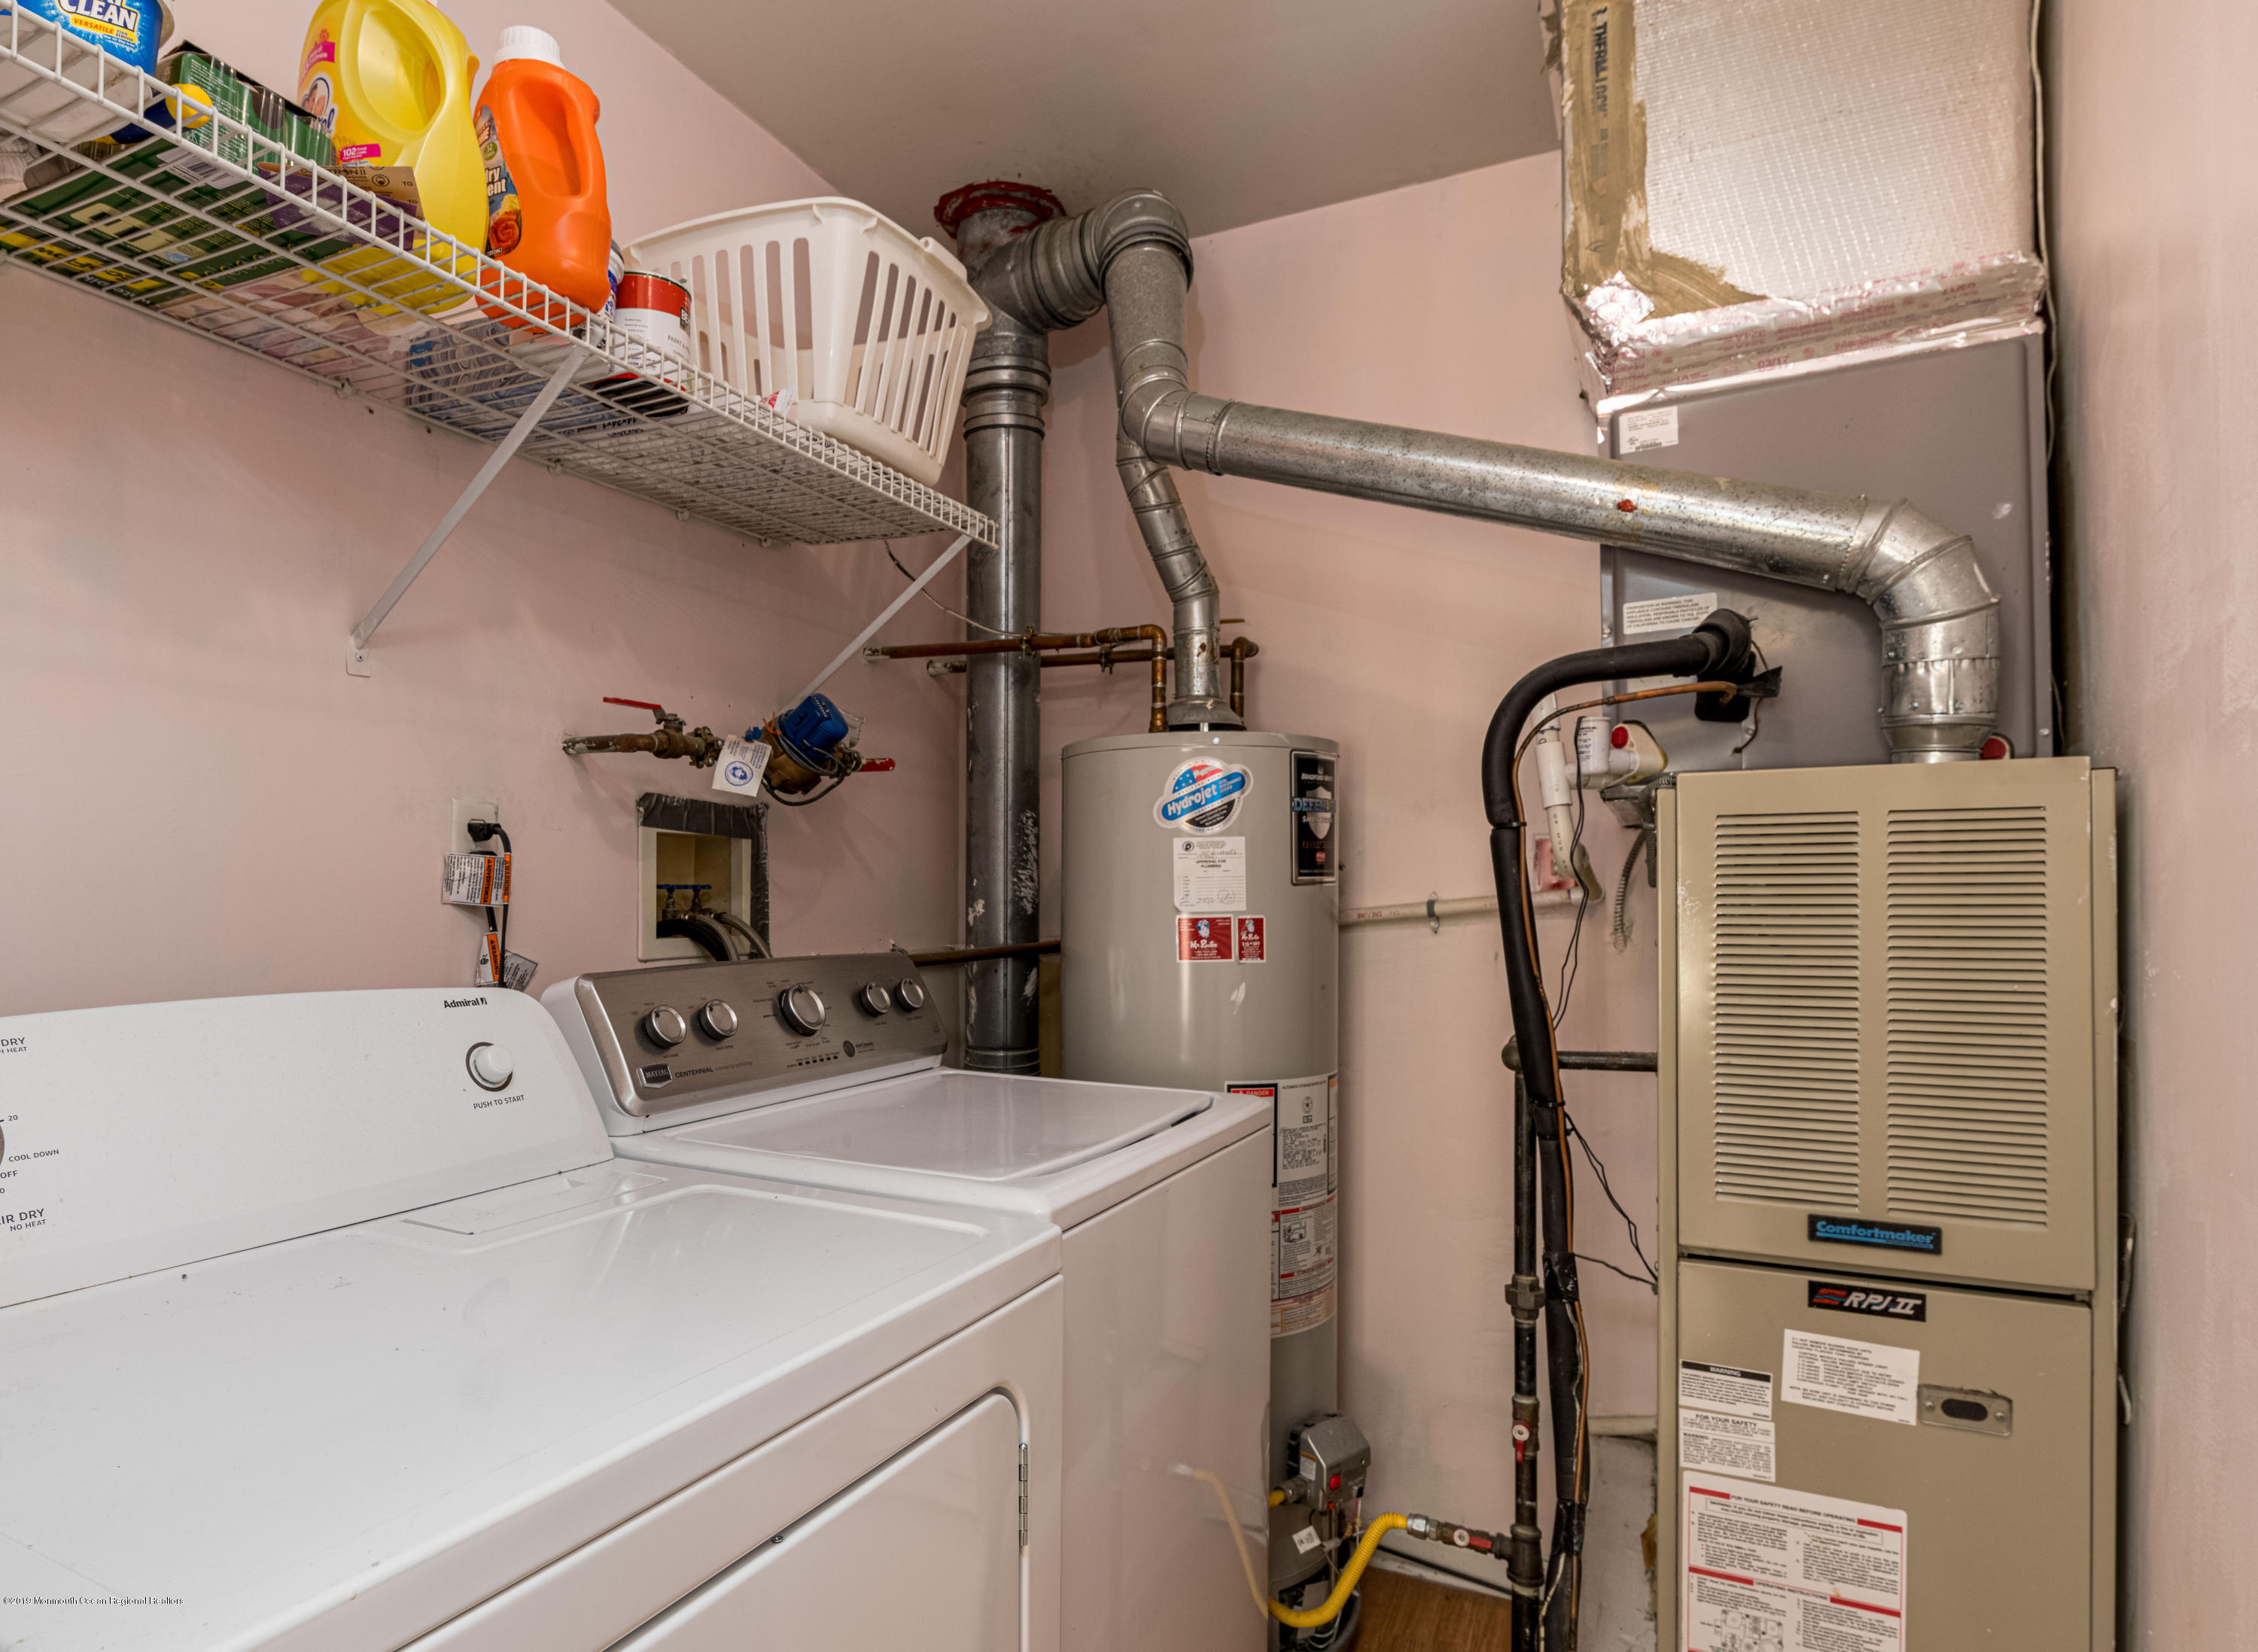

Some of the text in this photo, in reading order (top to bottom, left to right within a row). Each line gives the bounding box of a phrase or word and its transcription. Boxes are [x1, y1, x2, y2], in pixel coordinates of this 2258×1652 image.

[61, 0, 138, 31] CLEAN
[74, 18, 114, 35] VERSATILE
[342, 148, 357, 157] 102
[668, 335, 682, 346] PAINT
[1301, 773, 1324, 782] BRADFORD
[1167, 783, 1217, 816] Hydrojet
[482, 864, 493, 903] ADVERTENCIA
[1190, 939, 1218, 949] Mr. Rooter
[491, 945, 500, 975] WARNING
[444, 997, 480, 1009] Admiral
[1, 1037, 26, 1047] DRY
[645, 1069, 669, 1079] MAYTAG
[675, 1066, 714, 1079] CENTENNIAL
[473, 1100, 493, 1109] PUSH
[504, 1094, 525, 1104] START
[8, 1148, 59, 1162] COOL DOWN
[0, 1170, 18, 1179] OFF
[0, 1208, 44, 1225] IR DRY
[10, 1218, 47, 1231] NO HEAT
[1816, 1221, 1934, 1244] Comfortmaker
[1709, 1366, 1741, 1377] WARNING
[1731, 1419, 1757, 1428] SAFETY
[1823, 1512, 1855, 1522] OPERATING
[1754, 1581, 1827, 1601] OPERATING INSTRUCTIONS
